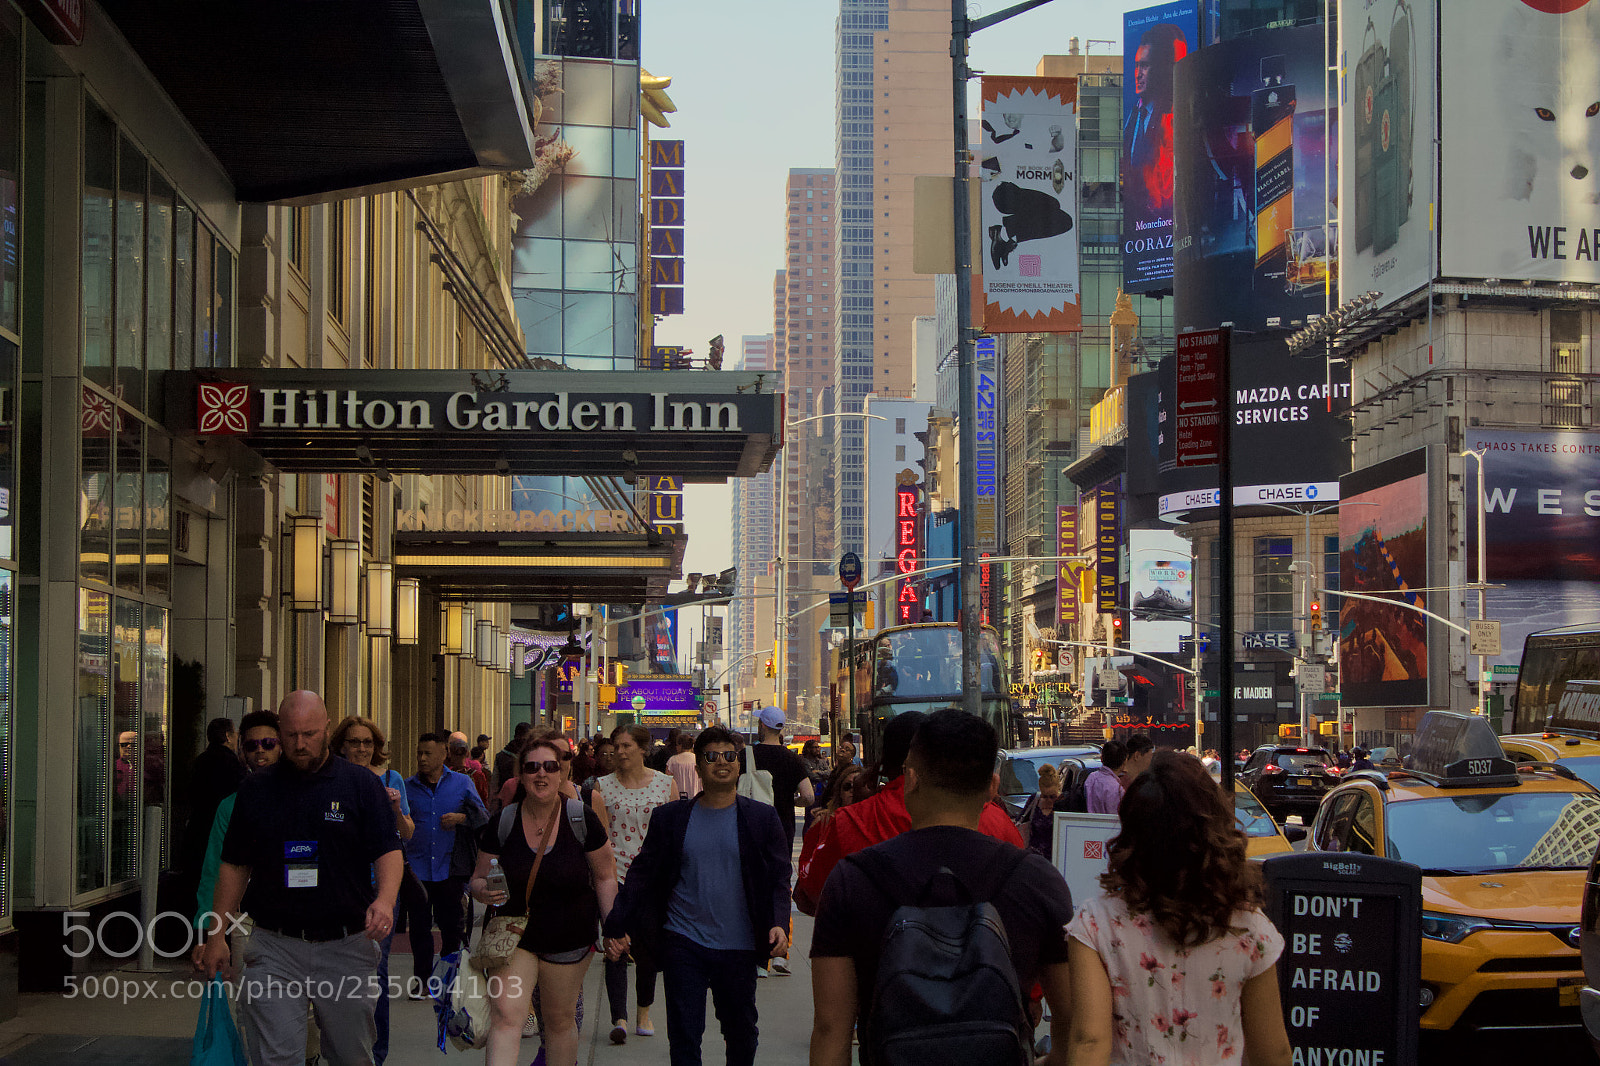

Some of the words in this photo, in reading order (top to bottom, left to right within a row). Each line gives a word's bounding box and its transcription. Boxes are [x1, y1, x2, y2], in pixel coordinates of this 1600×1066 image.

[1273, 166, 1292, 180] LABEL
[1528, 226, 1567, 260] WE
[1576, 228, 1600, 261] A
[1179, 337, 1189, 348] NO
[976, 338, 996, 372] NEW
[976, 373, 996, 409] 42
[1236, 386, 1291, 405] MAZDA
[257, 390, 434, 429] Hilton
[446, 391, 636, 431] Garden
[650, 392, 742, 431] Inn
[1236, 406, 1309, 425] SERVICES
[1179, 418, 1188, 428] NO
[1476, 441, 1516, 452] CHAOS
[1521, 443, 1557, 453] TAKES
[976, 431, 996, 496] STUDIOS
[1185, 492, 1212, 506] CHASE
[1258, 487, 1303, 500] CHASE
[397, 509, 629, 532] KNICKERBOCKER
[1100, 489, 1115, 567] VICTORY
[1100, 574, 1115, 610] NEW
[1061, 588, 1075, 620] NEW
[1028, 682, 1074, 695] POER
[1244, 687, 1273, 699] MADDEN
[1468, 760, 1492, 774] 5D37
[1323, 862, 1361, 871] BigBelly
[1294, 895, 1363, 918] DON'T
[1293, 933, 1322, 955] BE
[1291, 967, 1381, 992] AFRAID
[1290, 1006, 1320, 1028] OF
[1291, 1046, 1385, 1066] ANYONE
